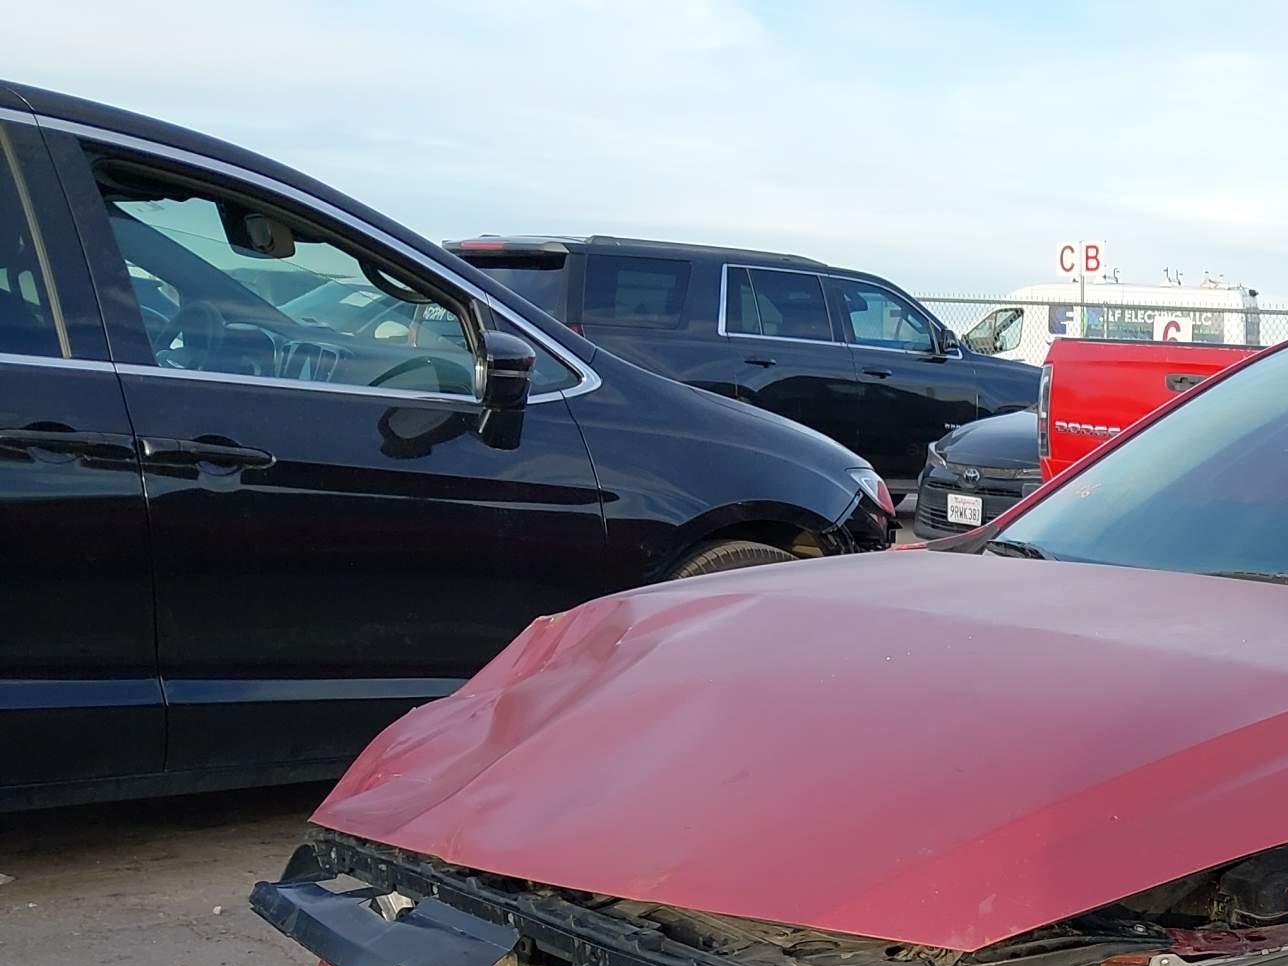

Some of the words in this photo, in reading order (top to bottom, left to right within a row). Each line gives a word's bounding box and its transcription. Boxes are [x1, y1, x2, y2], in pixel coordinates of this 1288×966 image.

[1060, 245, 1075, 272] C
[1085, 245, 1100, 272] B
[1055, 421, 1121, 437] DODGE
